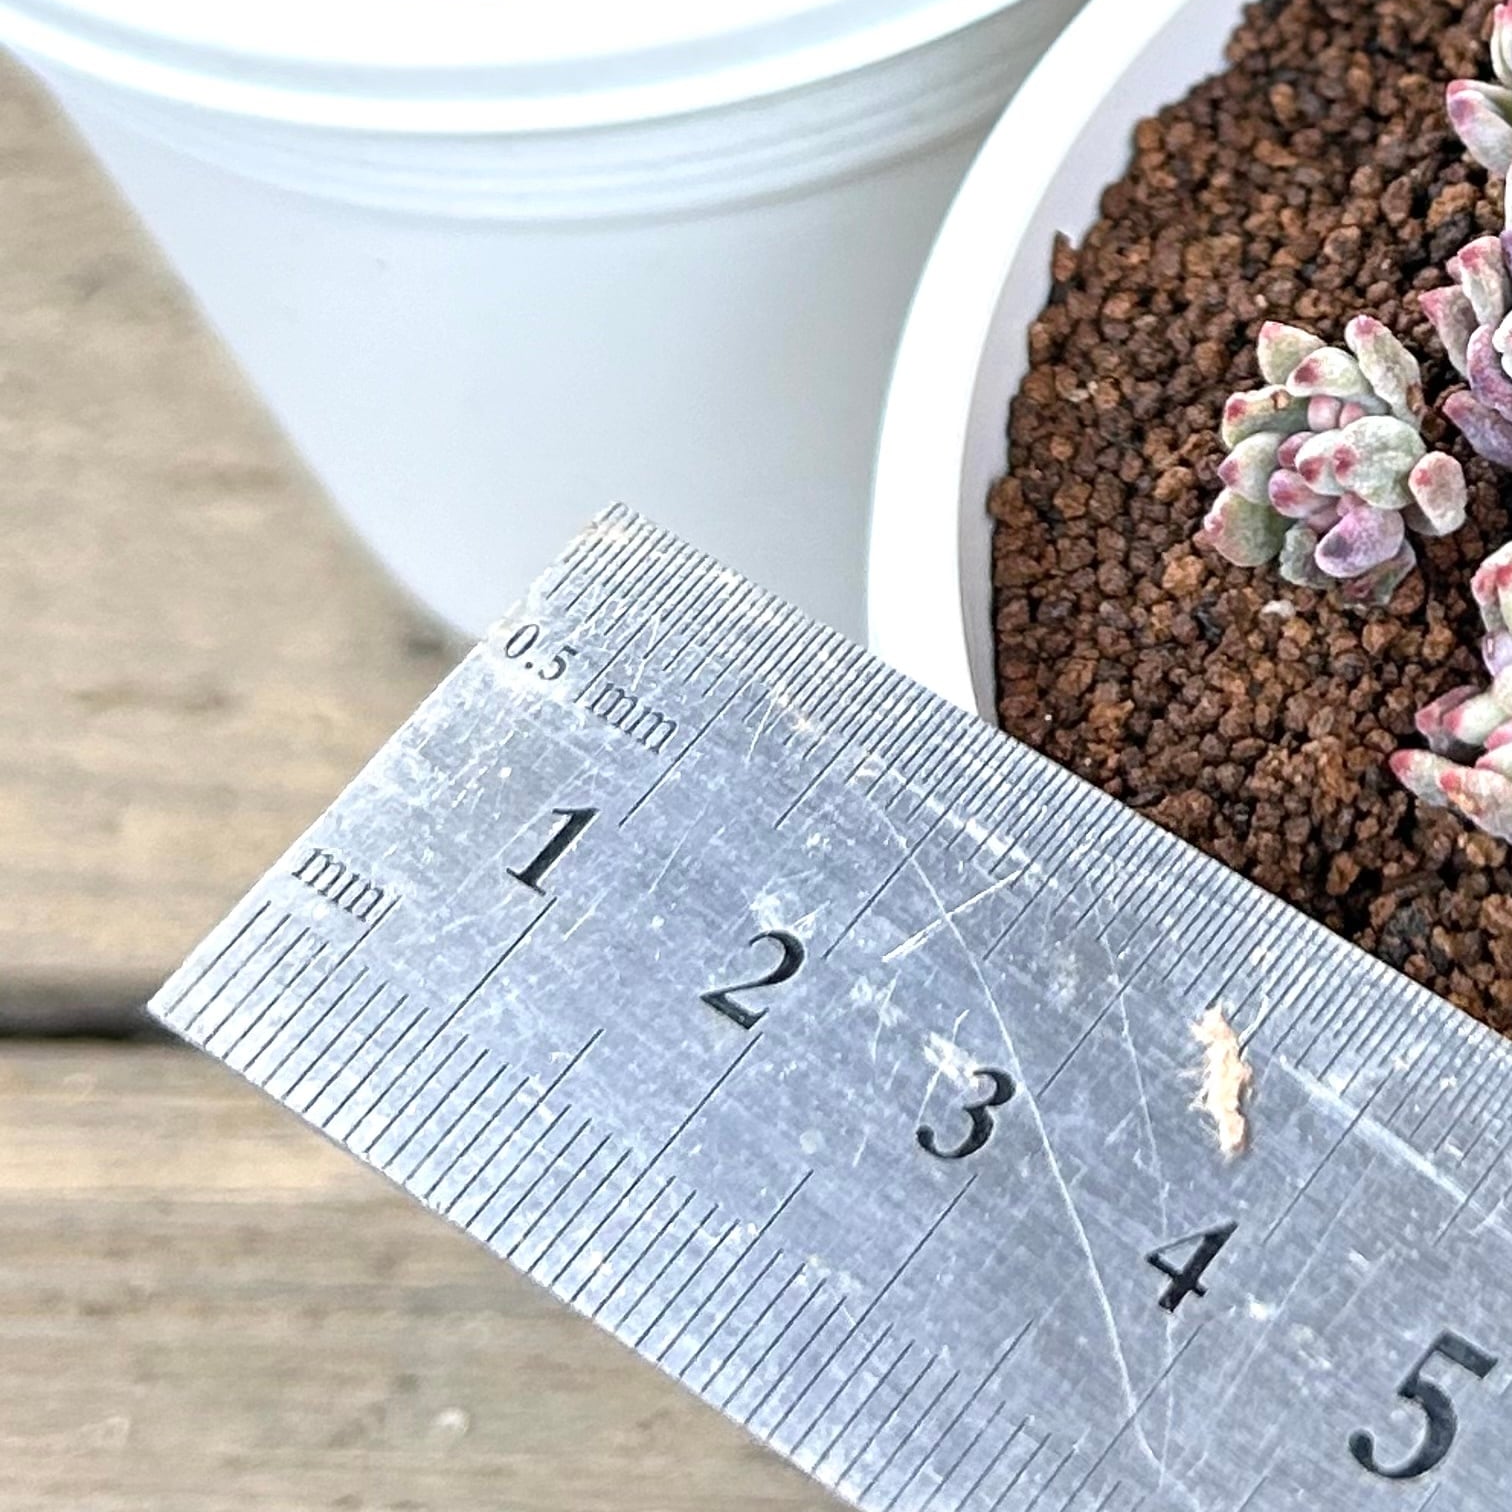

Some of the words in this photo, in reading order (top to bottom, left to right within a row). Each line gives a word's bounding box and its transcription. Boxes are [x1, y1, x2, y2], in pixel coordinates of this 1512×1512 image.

[502, 620, 578, 684] 0.5
[585, 682, 679, 756] mm
[291, 843, 387, 925] mm
[506, 805, 600, 898] 1
[700, 928, 805, 1032] 2
[916, 1066, 1016, 1160] 3
[1144, 1220, 1239, 1313] 4
[1347, 1328, 1499, 1480] 5
